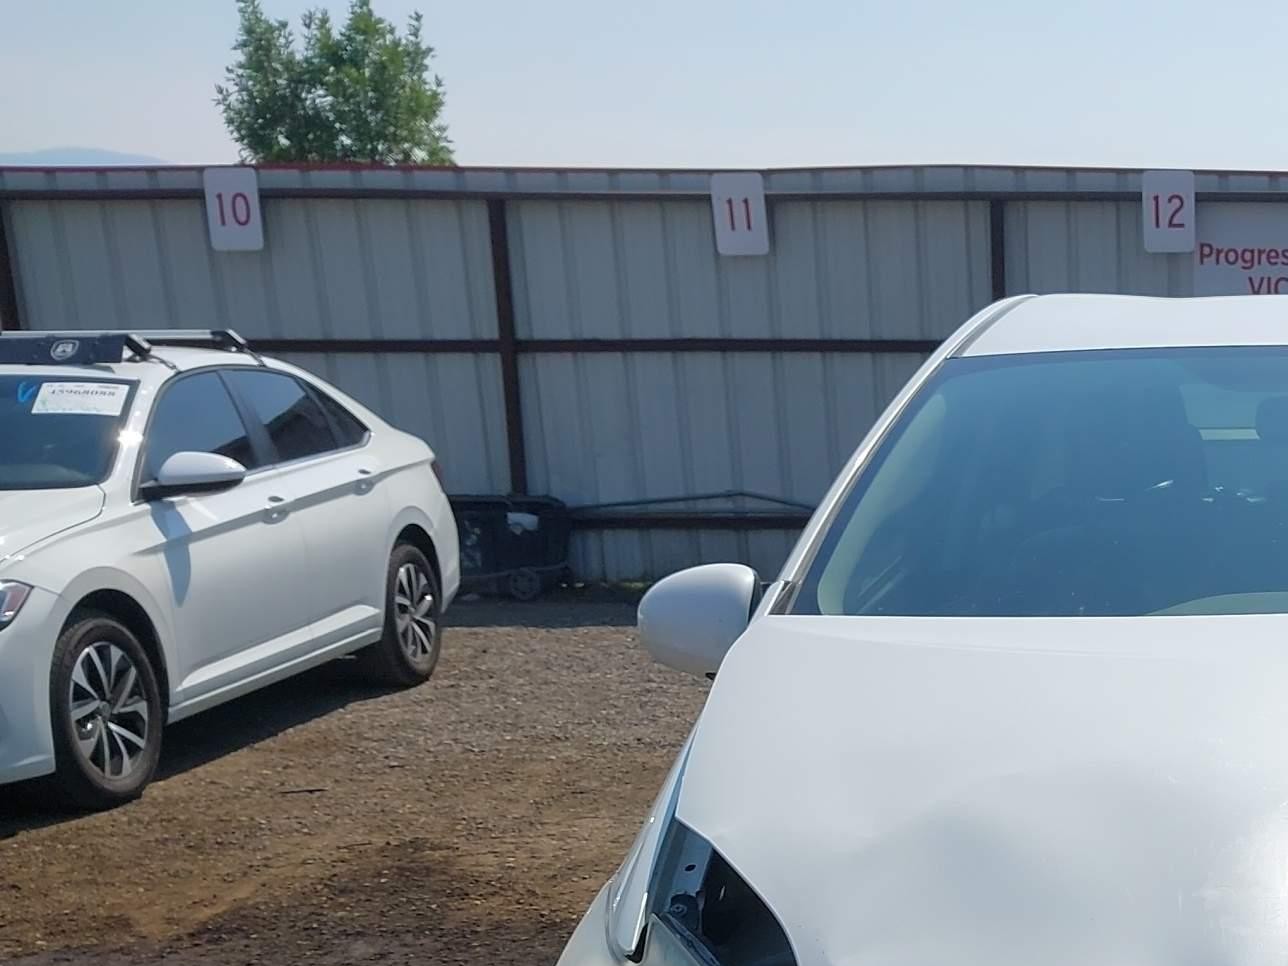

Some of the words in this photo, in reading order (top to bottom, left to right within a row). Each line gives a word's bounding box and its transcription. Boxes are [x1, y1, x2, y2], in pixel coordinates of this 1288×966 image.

[216, 192, 251, 227] 10
[726, 197, 752, 232] 11
[1152, 194, 1185, 229] 12
